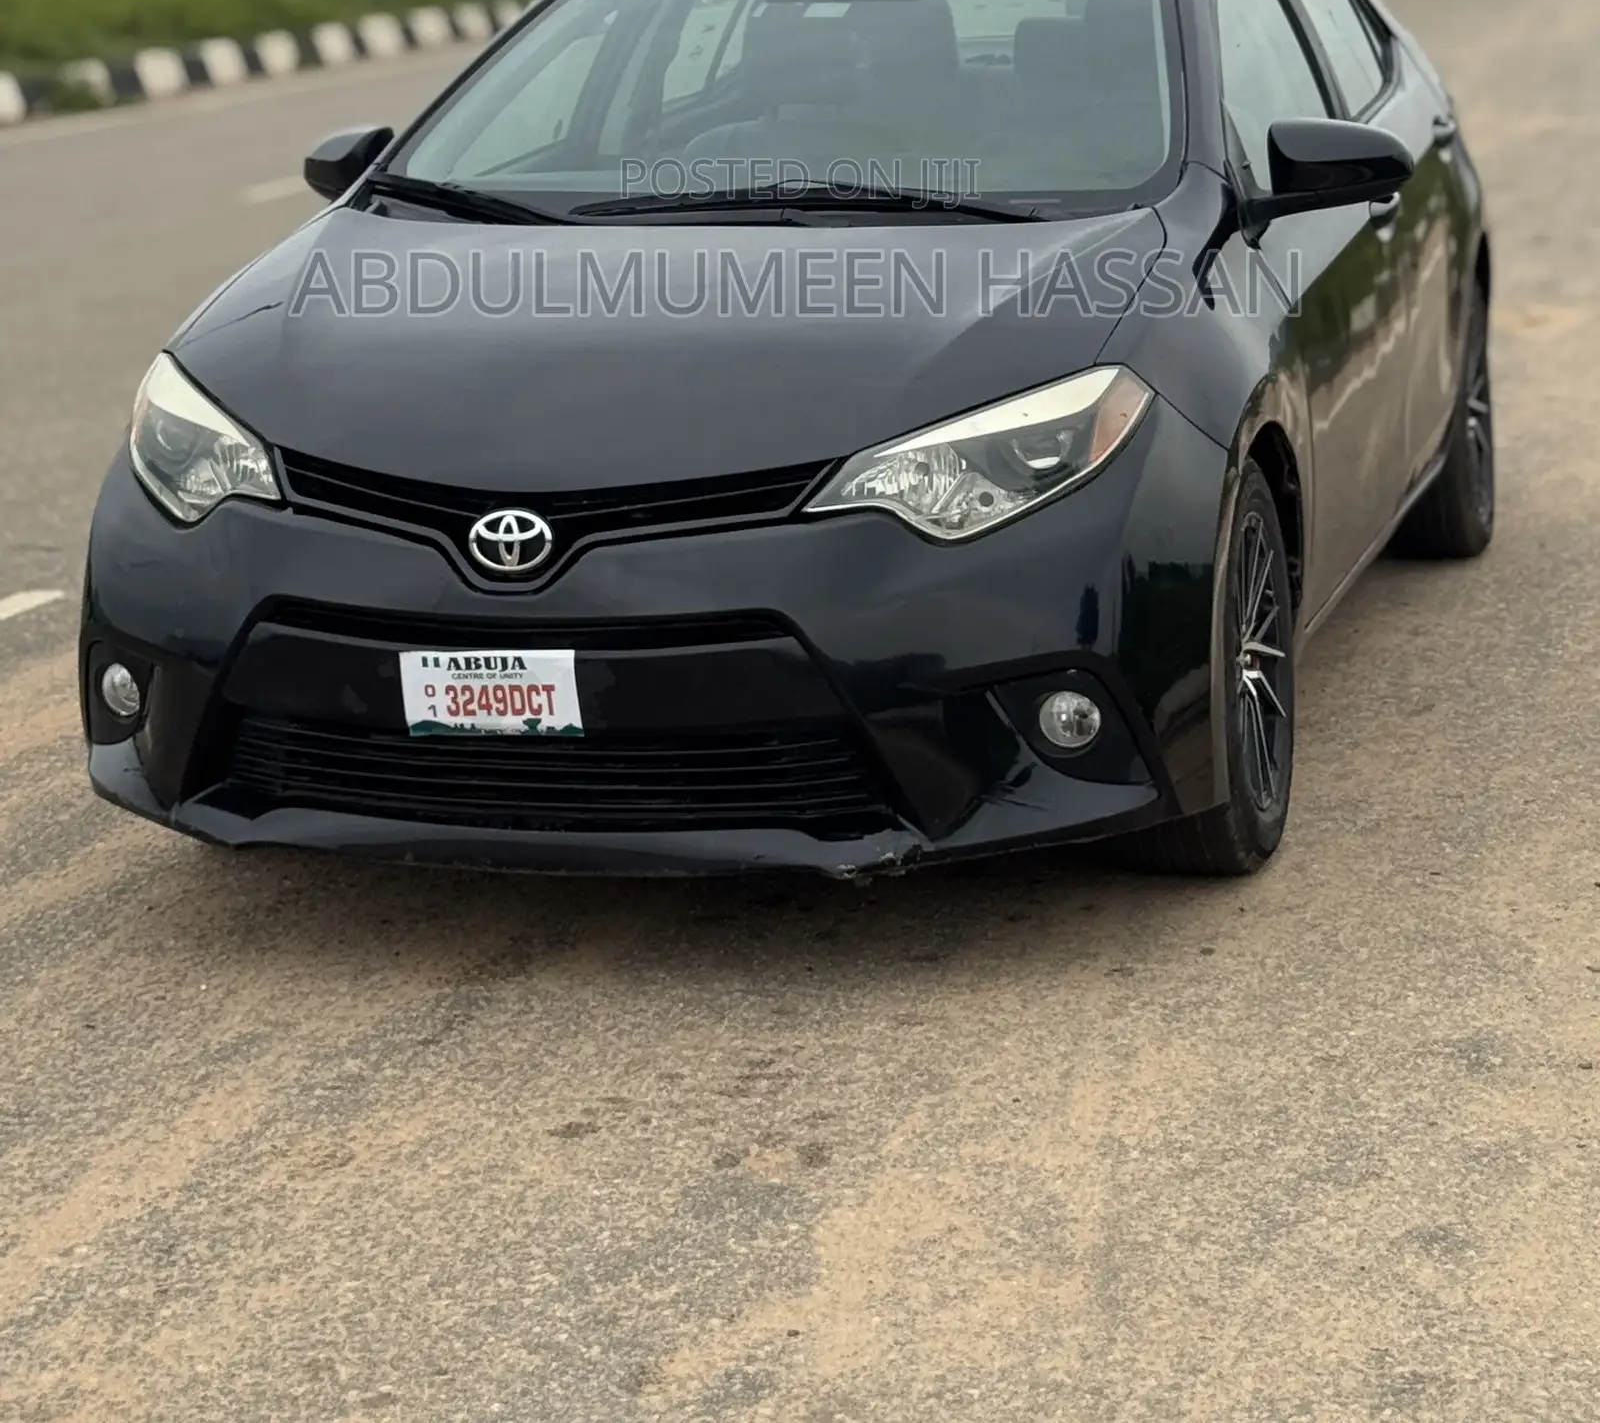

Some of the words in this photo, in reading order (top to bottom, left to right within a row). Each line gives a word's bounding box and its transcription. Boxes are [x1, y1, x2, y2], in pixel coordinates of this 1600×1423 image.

[446, 656, 528, 672] ABUJA
[451, 672, 484, 680] CENTRE
[485, 672, 498, 680] OF
[445, 683, 556, 717] 3249DCT
